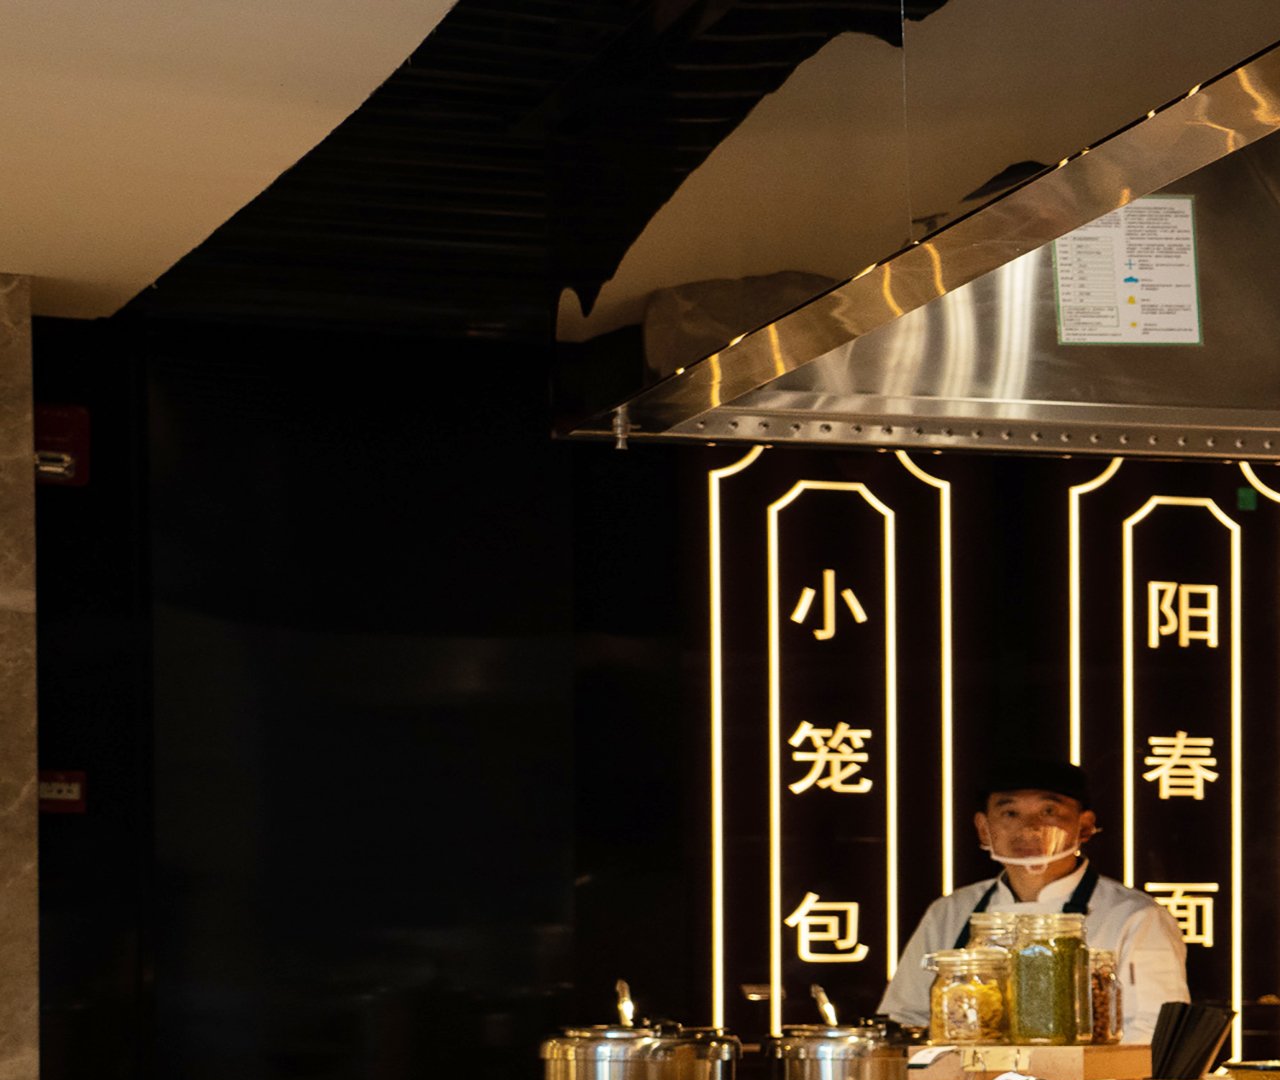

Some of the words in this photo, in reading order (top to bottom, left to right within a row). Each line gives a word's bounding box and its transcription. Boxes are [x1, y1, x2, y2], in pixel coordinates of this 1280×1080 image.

[786, 570, 872, 964] 小笼包
[1143, 581, 1220, 948] 阳春面
